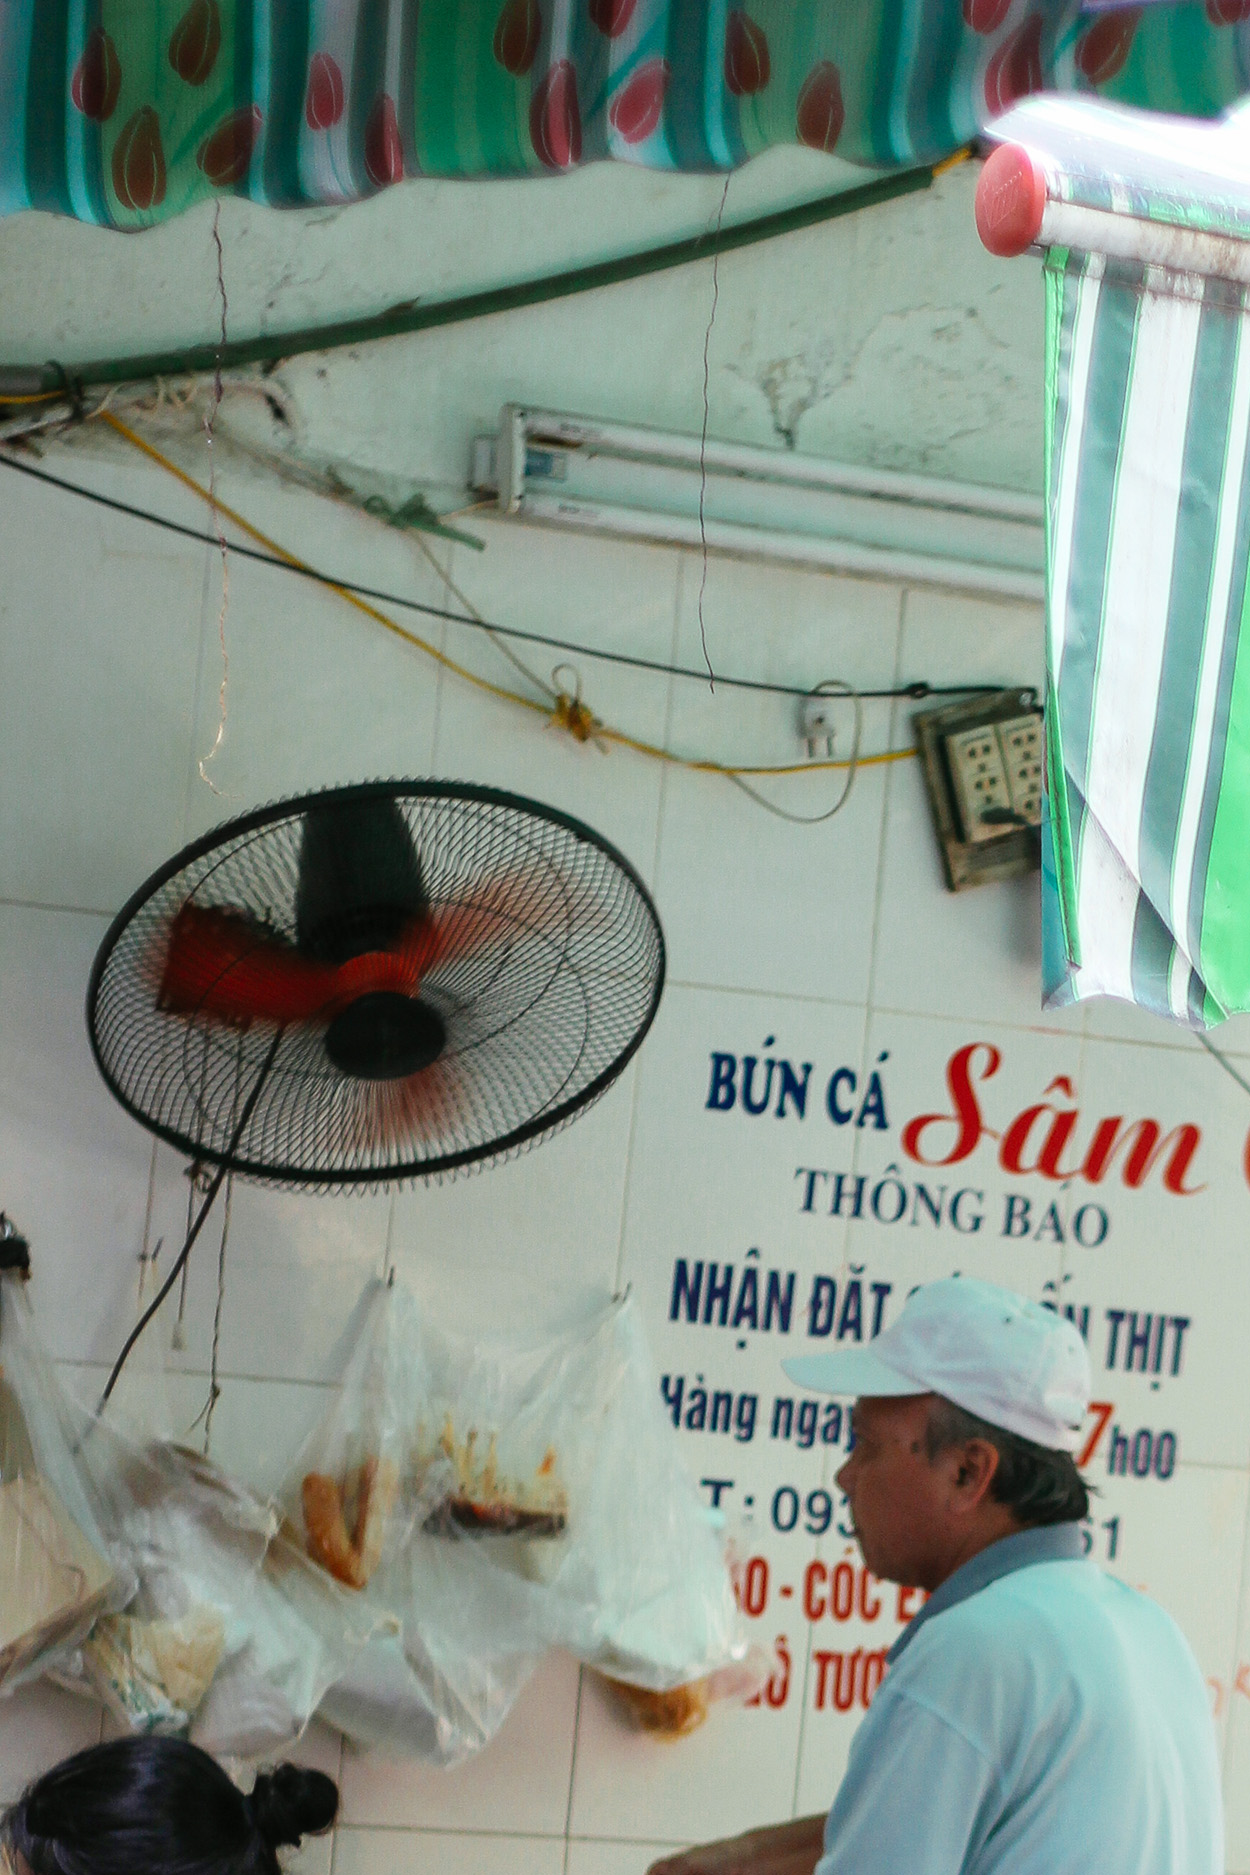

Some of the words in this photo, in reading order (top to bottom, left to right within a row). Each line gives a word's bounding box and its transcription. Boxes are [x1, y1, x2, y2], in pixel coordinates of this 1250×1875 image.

[705, 1036, 809, 1120] BÚN
[826, 1051, 890, 1130] CÁ
[901, 1042, 1207, 1196] Sâm
[795, 1164, 985, 1234] THÔNG
[669, 1247, 796, 1350] NHẬN
[1106, 1309, 1190, 1391] THỊT
